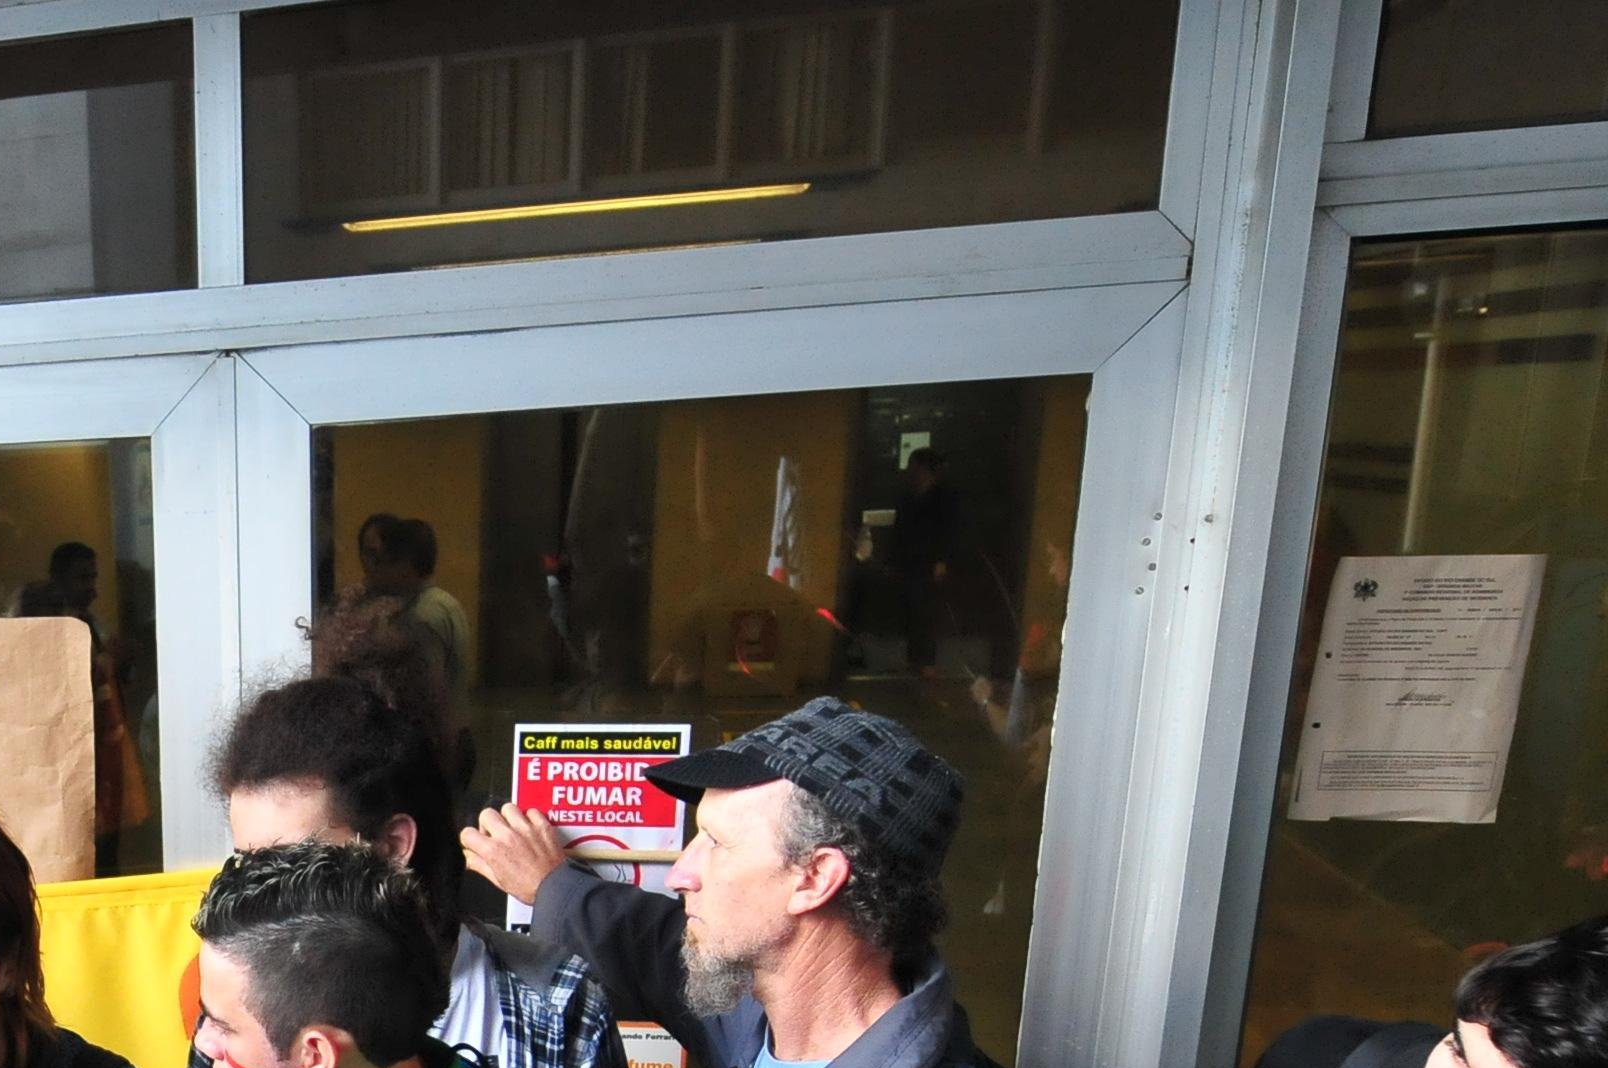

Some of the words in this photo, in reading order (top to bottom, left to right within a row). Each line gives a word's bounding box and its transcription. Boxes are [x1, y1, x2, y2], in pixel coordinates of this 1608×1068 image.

[524, 736, 558, 749] Caff
[561, 737, 599, 750] mais
[603, 736, 677, 750] saudável
[527, 757, 541, 781] É
[547, 761, 651, 782] PROIBID
[552, 786, 642, 806] FUMAR
[548, 810, 594, 823] NESTE
[597, 811, 644, 824] LOCAL
